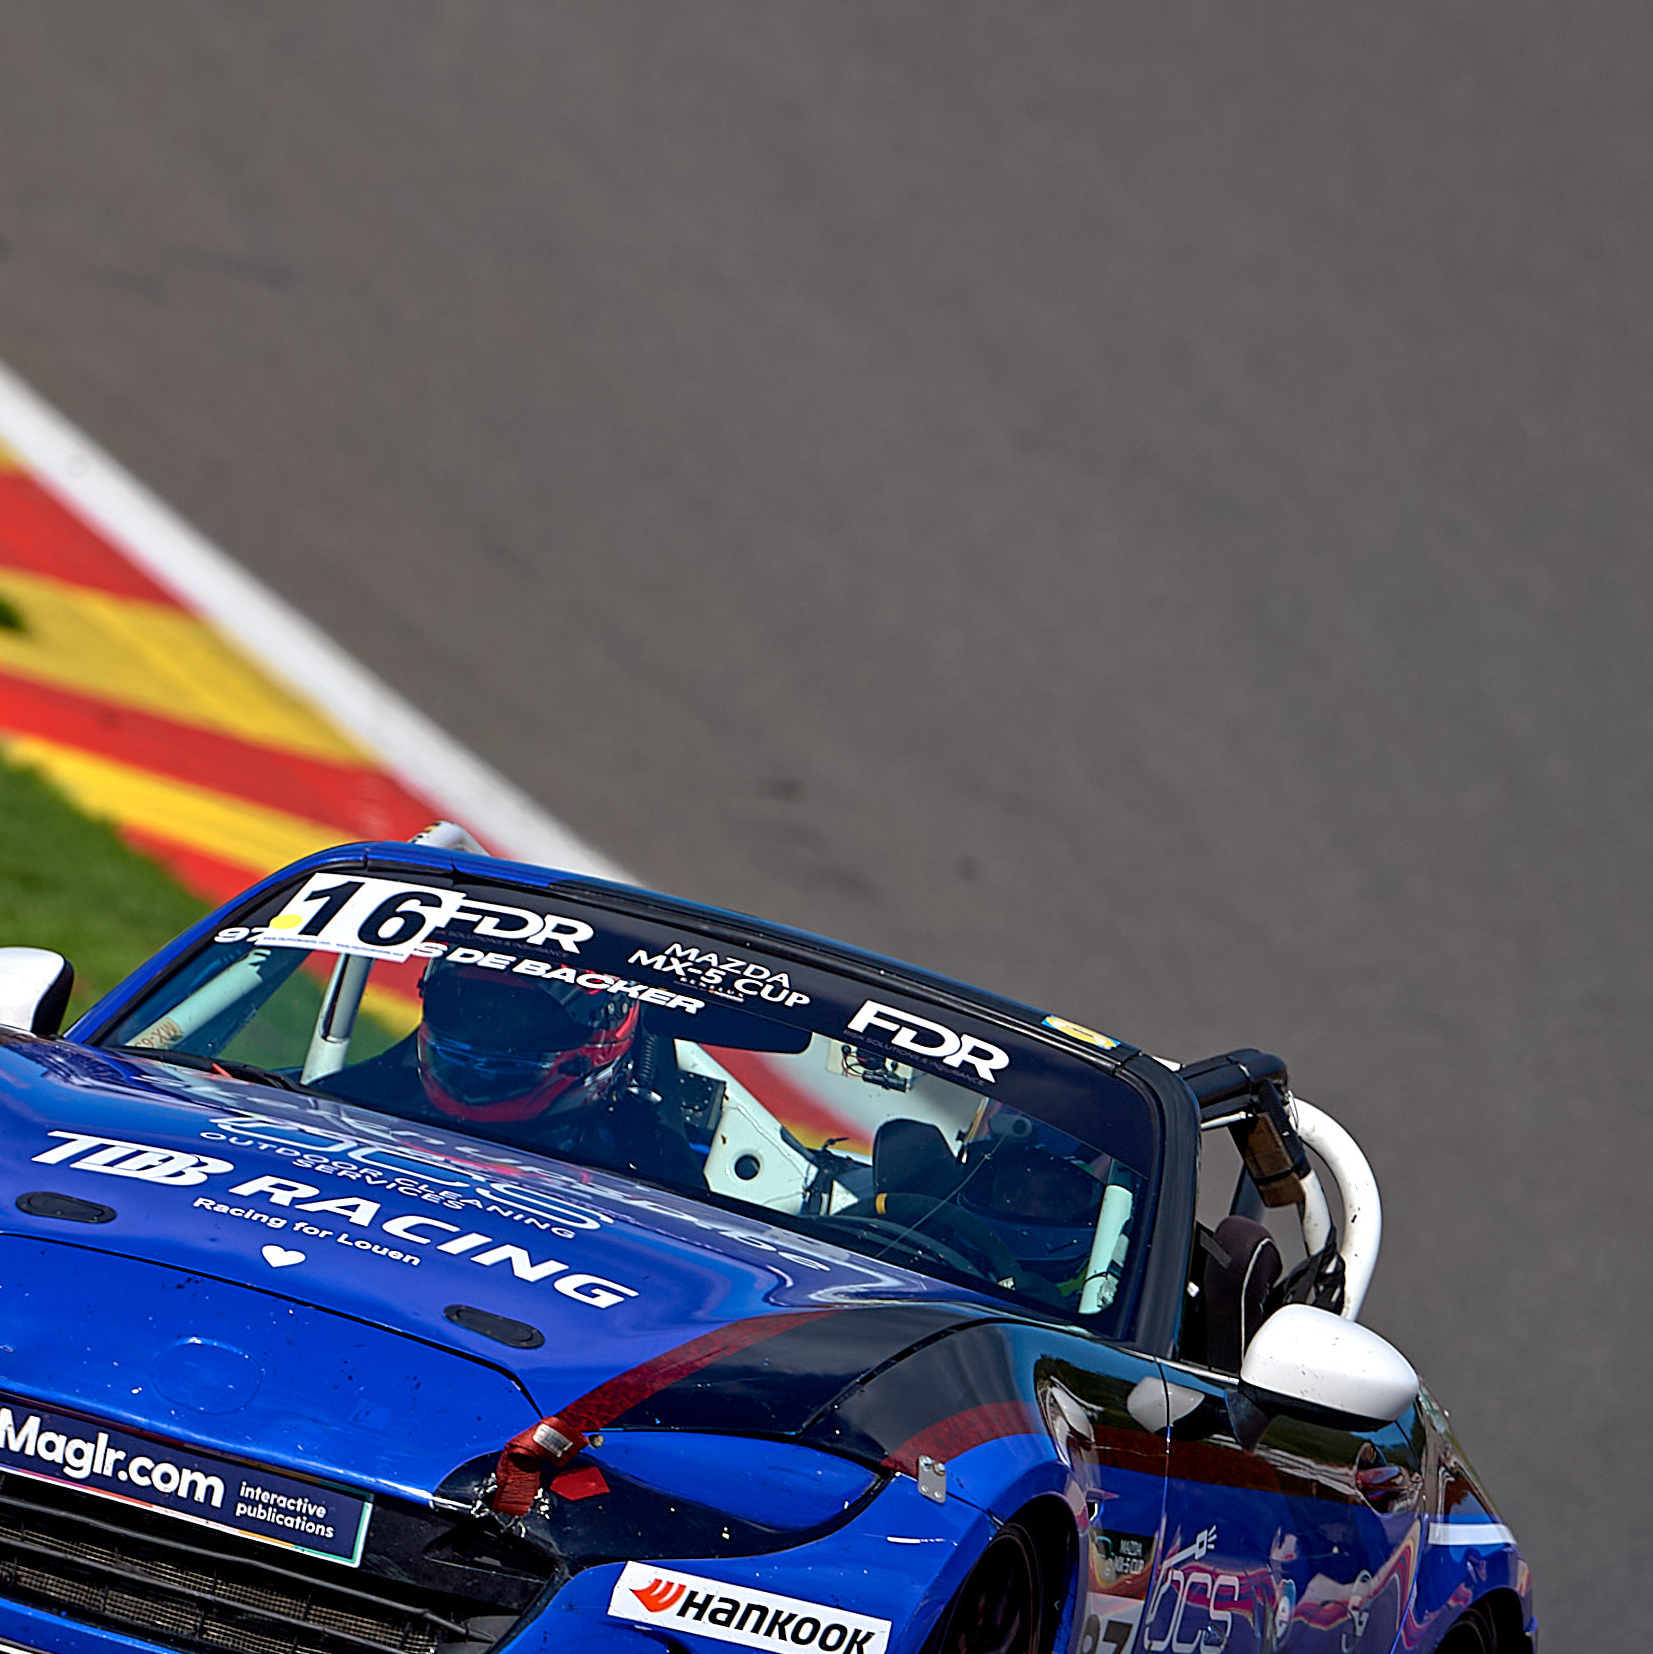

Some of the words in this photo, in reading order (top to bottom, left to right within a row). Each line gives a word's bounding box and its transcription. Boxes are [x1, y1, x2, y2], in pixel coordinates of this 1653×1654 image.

[297, 880, 443, 947] 16
[435, 896, 594, 954] FDR
[445, 946, 517, 971] DE
[512, 958, 706, 1014] BACKER
[627, 949, 727, 986] MX-5
[733, 978, 811, 1008] CUP
[664, 942, 791, 989] MAZDA
[847, 1000, 1010, 1083] FDR
[199, 1130, 384, 1178] OUTDOOR
[394, 1176, 576, 1240] CLEANING
[291, 1157, 467, 1211] SERVICES
[193, 1197, 288, 1230] Racing
[292, 1220, 335, 1240] for
[336, 1232, 423, 1268] Louen
[228, 1174, 640, 1309] RACING
[235, 1501, 335, 1540] publications
[239, 1480, 327, 1520] interactive
